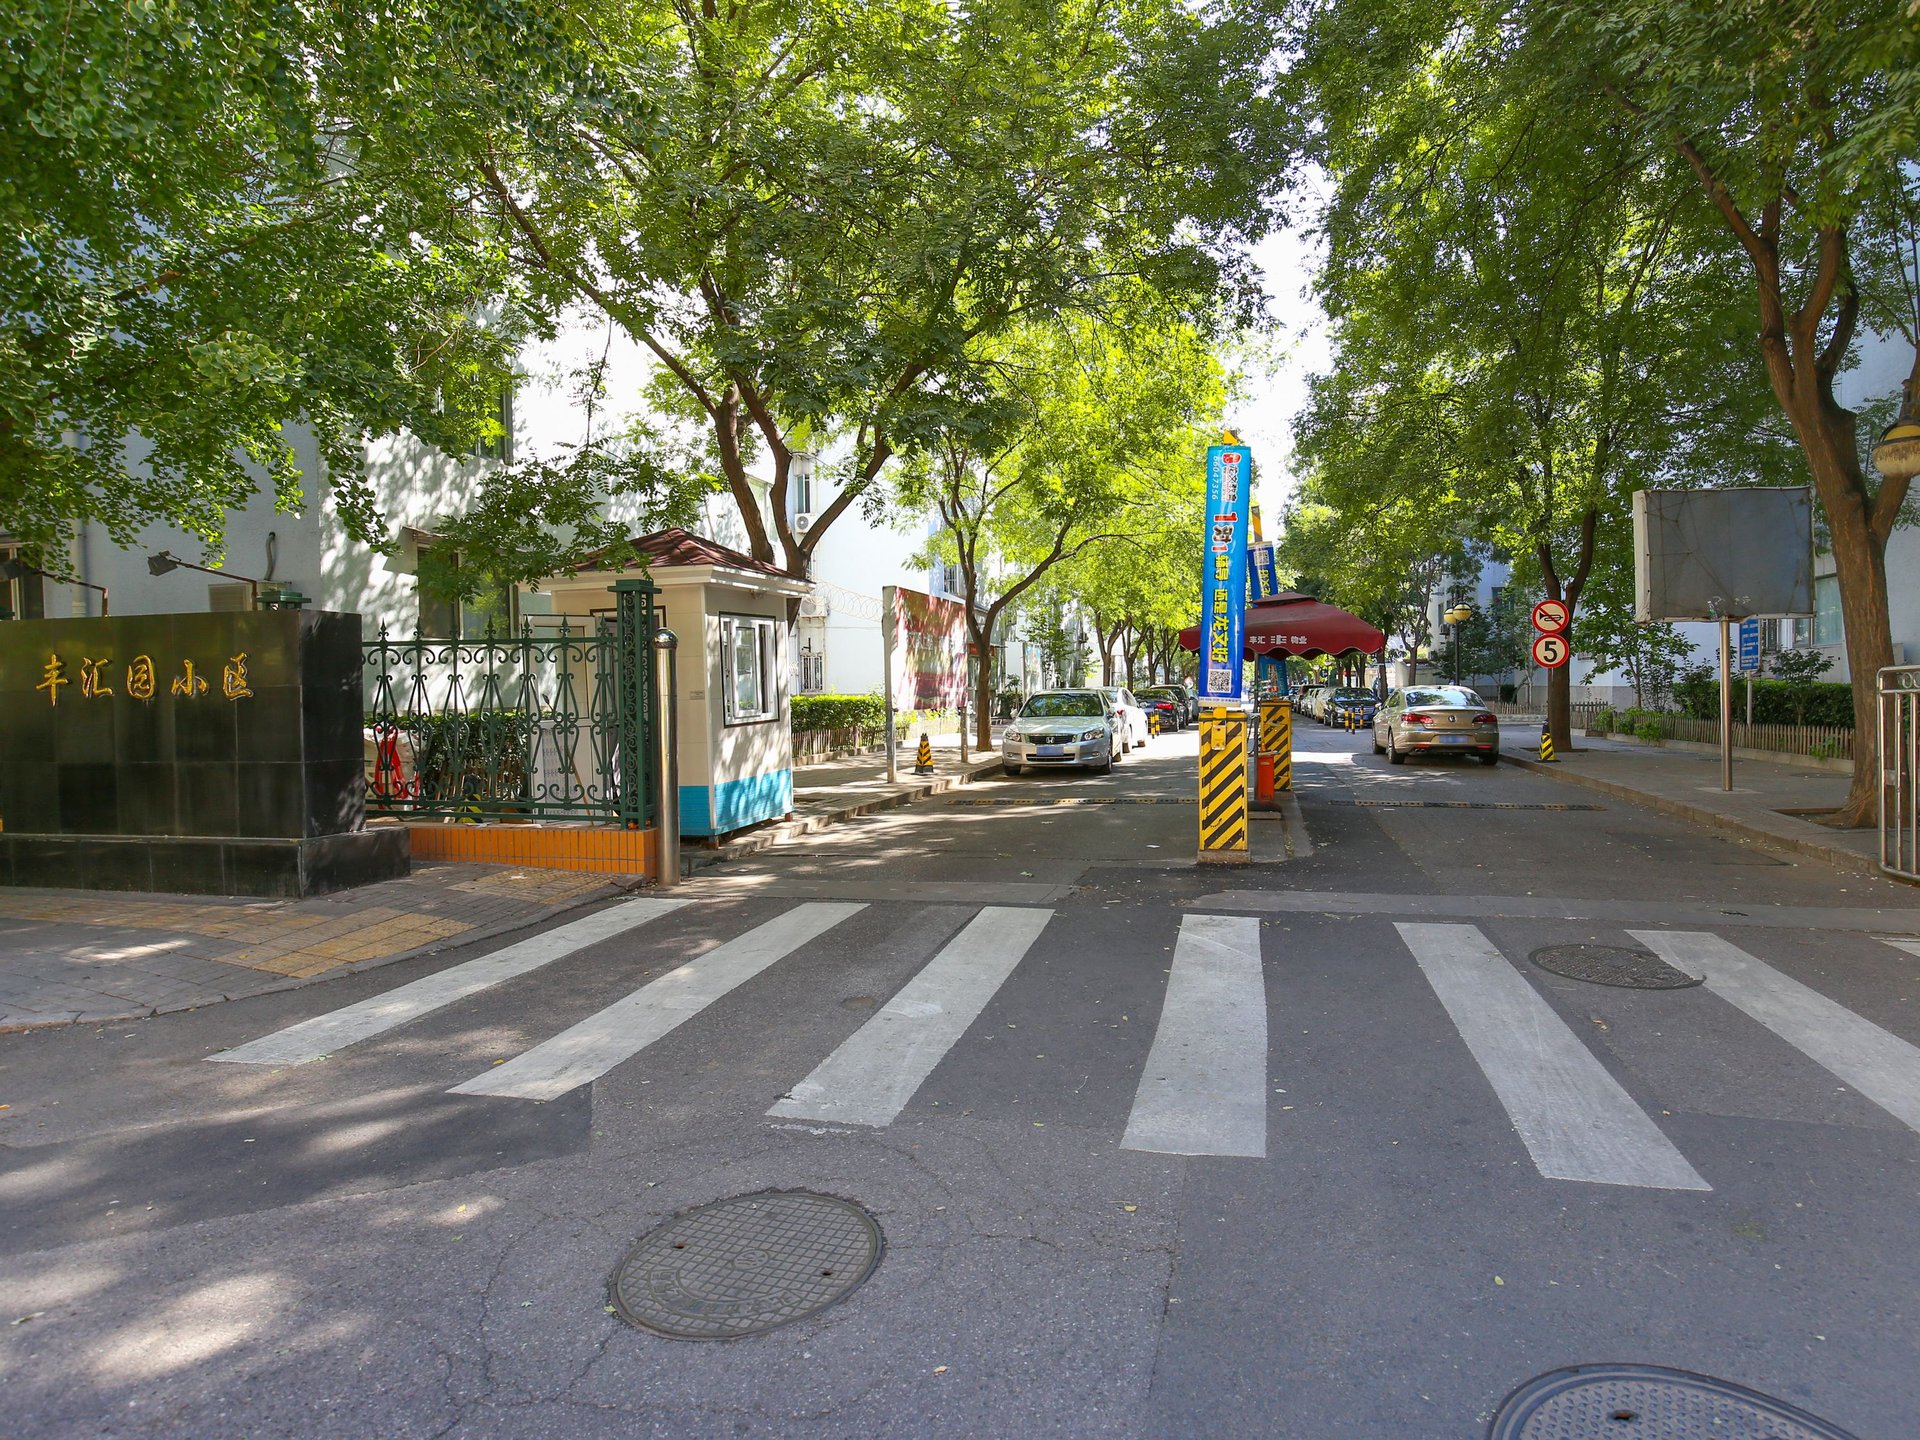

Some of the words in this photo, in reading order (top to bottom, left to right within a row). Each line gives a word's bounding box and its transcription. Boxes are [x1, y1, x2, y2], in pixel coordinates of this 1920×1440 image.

[1212, 588, 1229, 663] 还是龙文好
[1543, 640, 1558, 663] 5
[35, 652, 254, 706] 丰汇园小区
